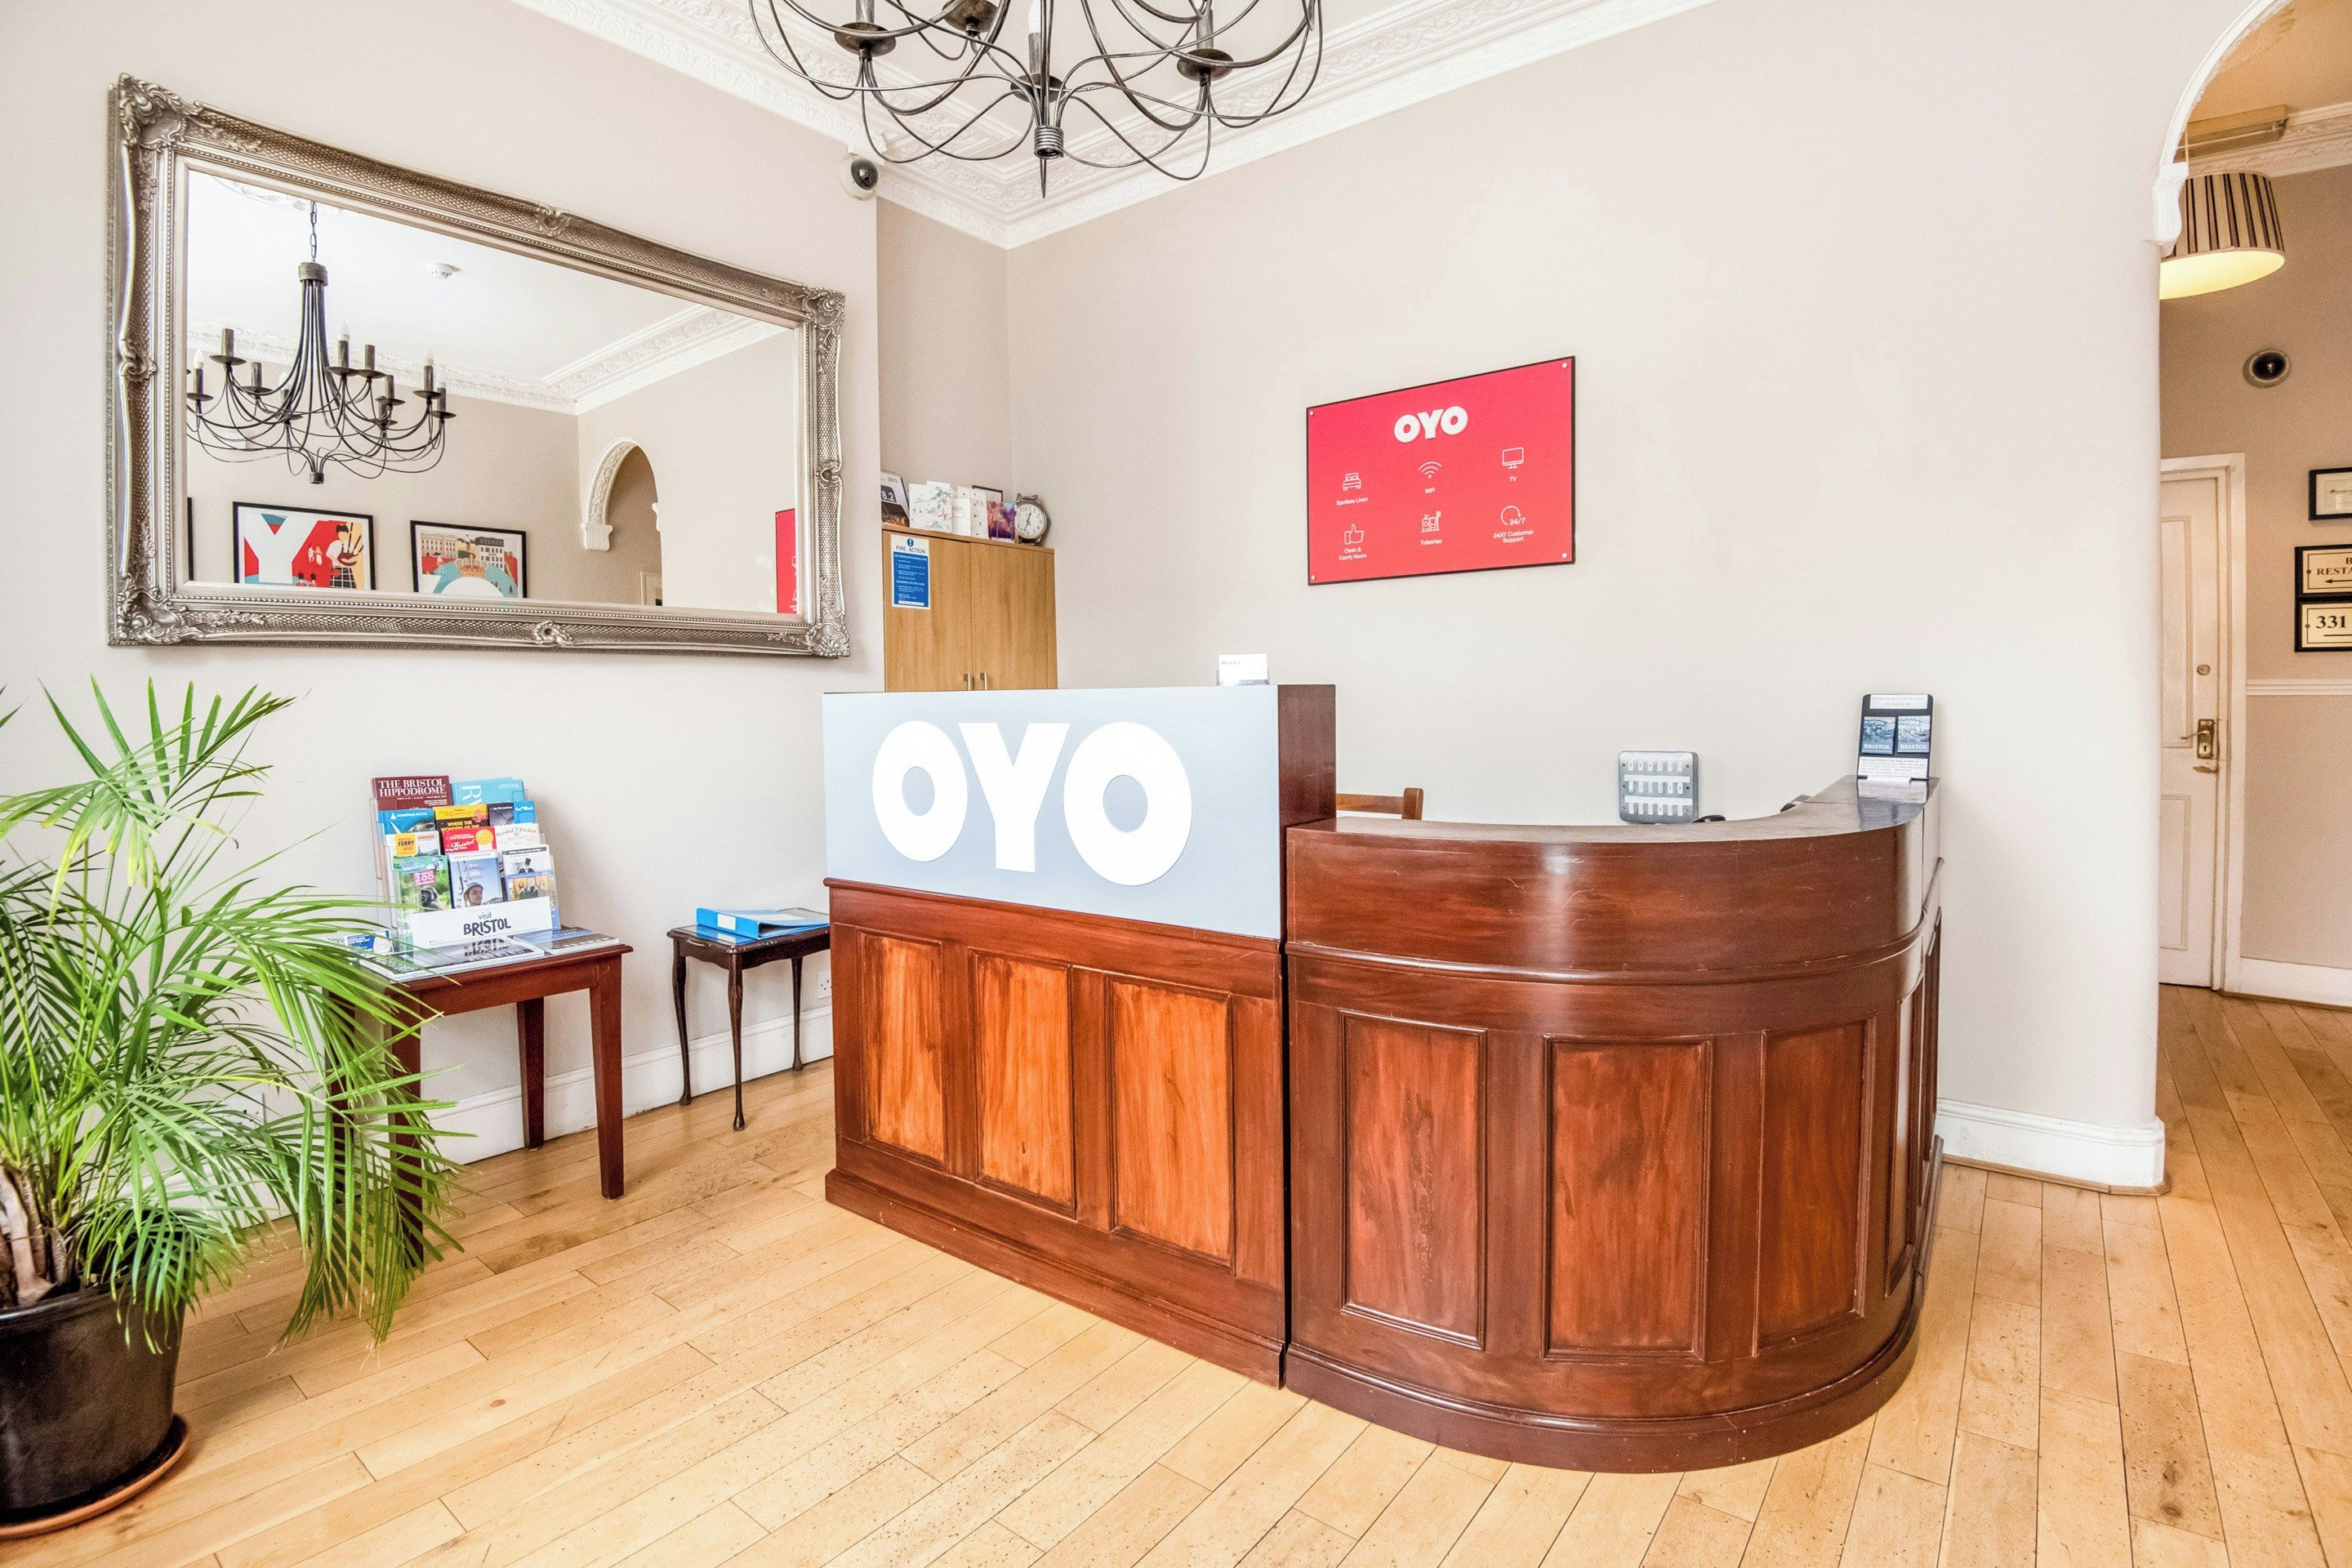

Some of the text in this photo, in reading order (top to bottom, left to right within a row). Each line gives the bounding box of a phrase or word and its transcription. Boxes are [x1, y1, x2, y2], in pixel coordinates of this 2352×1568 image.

[1394, 406, 1468, 443] OYO
[1336, 498, 1356, 506] Spotless
[2316, 615, 2346, 629] 331
[378, 778, 446, 789] THE BRISTOL
[379, 786, 447, 797] HIPPODROME
[871, 720, 1192, 886] OYO
[414, 874, 435, 883] ZOO
[477, 911, 492, 920] visit
[463, 917, 511, 937] BRISTOL
